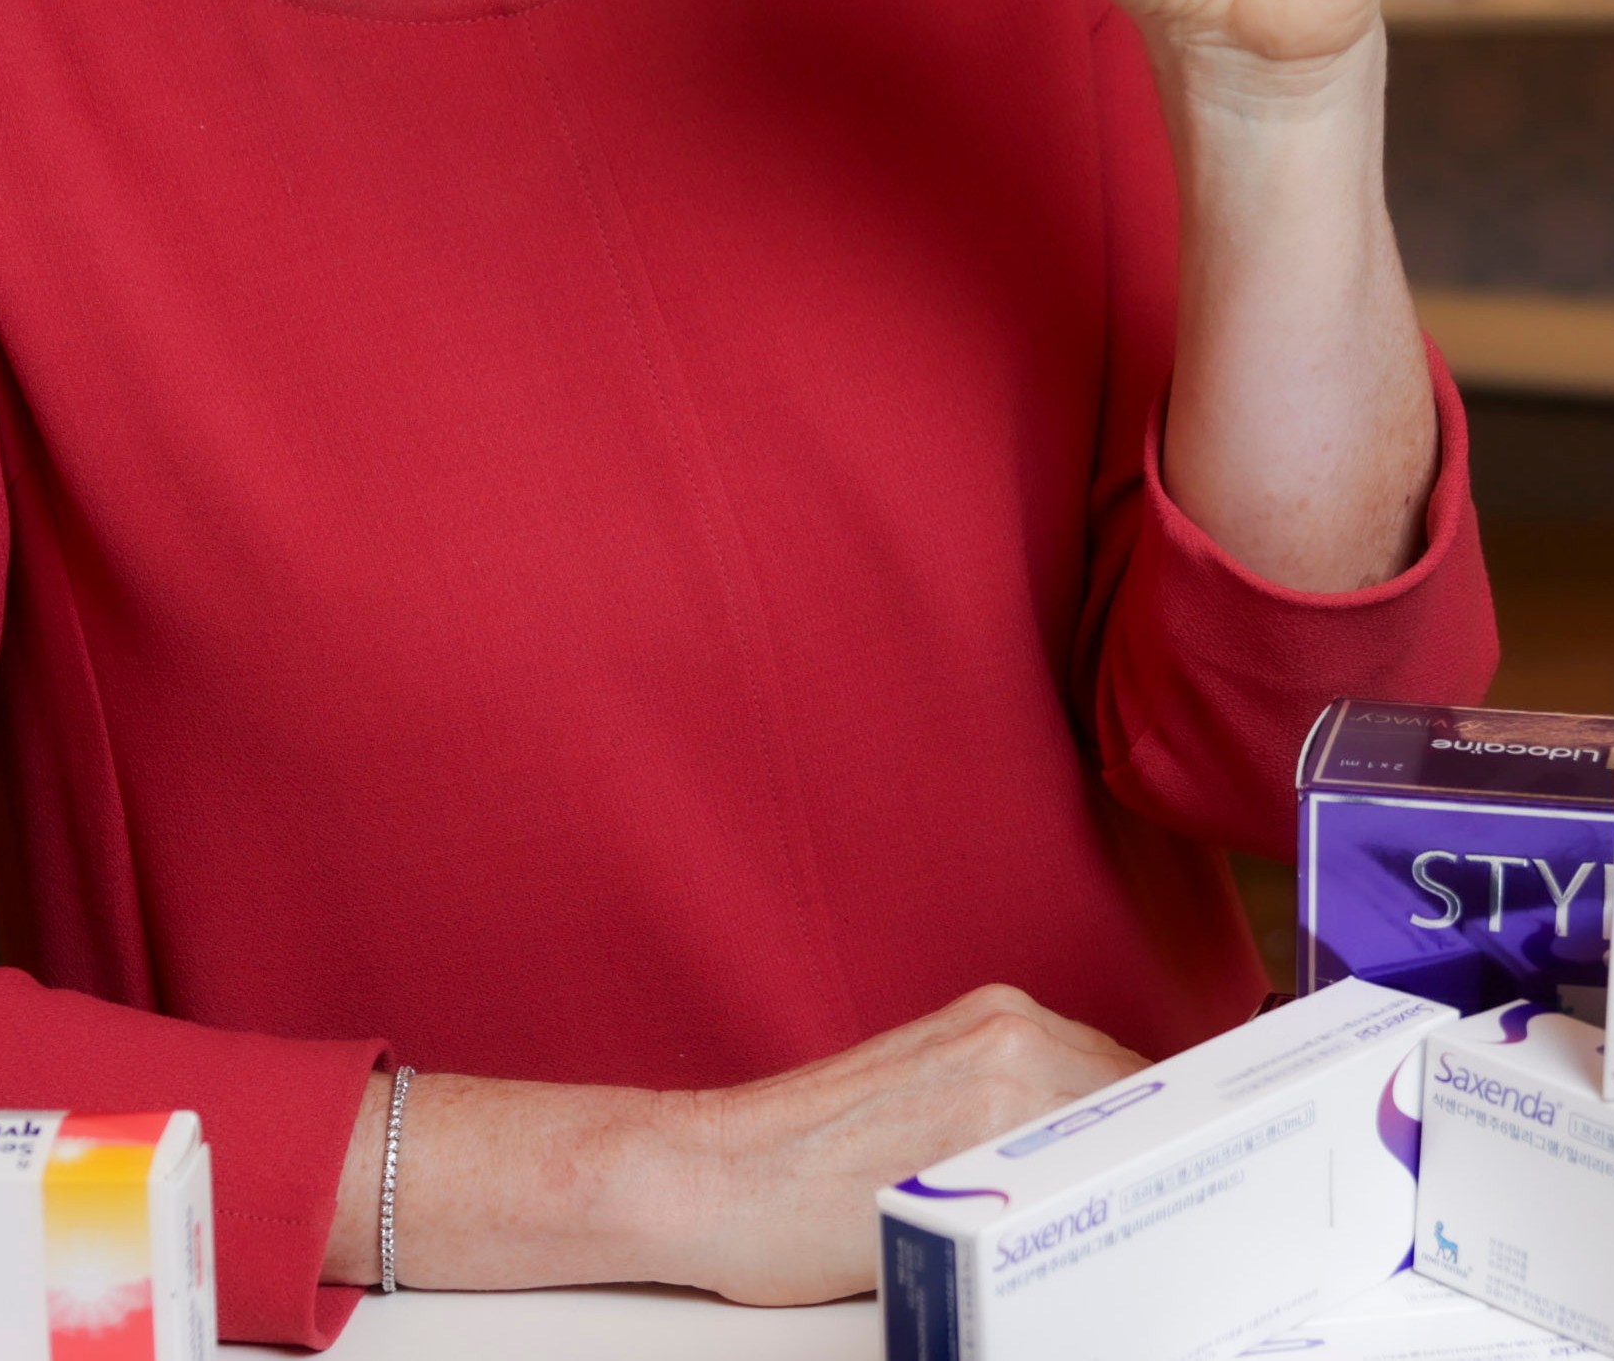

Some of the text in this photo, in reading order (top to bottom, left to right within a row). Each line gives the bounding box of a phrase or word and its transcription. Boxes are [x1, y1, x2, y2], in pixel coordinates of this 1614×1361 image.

[1355, 711, 1448, 730] VIVACY
[1430, 738, 1600, 764] Lidocaïne
[1353, 1002, 1435, 1045] Saxenda
[1433, 1051, 1557, 1126] Saxenda
[993, 1193, 1109, 1272] Saxenda
